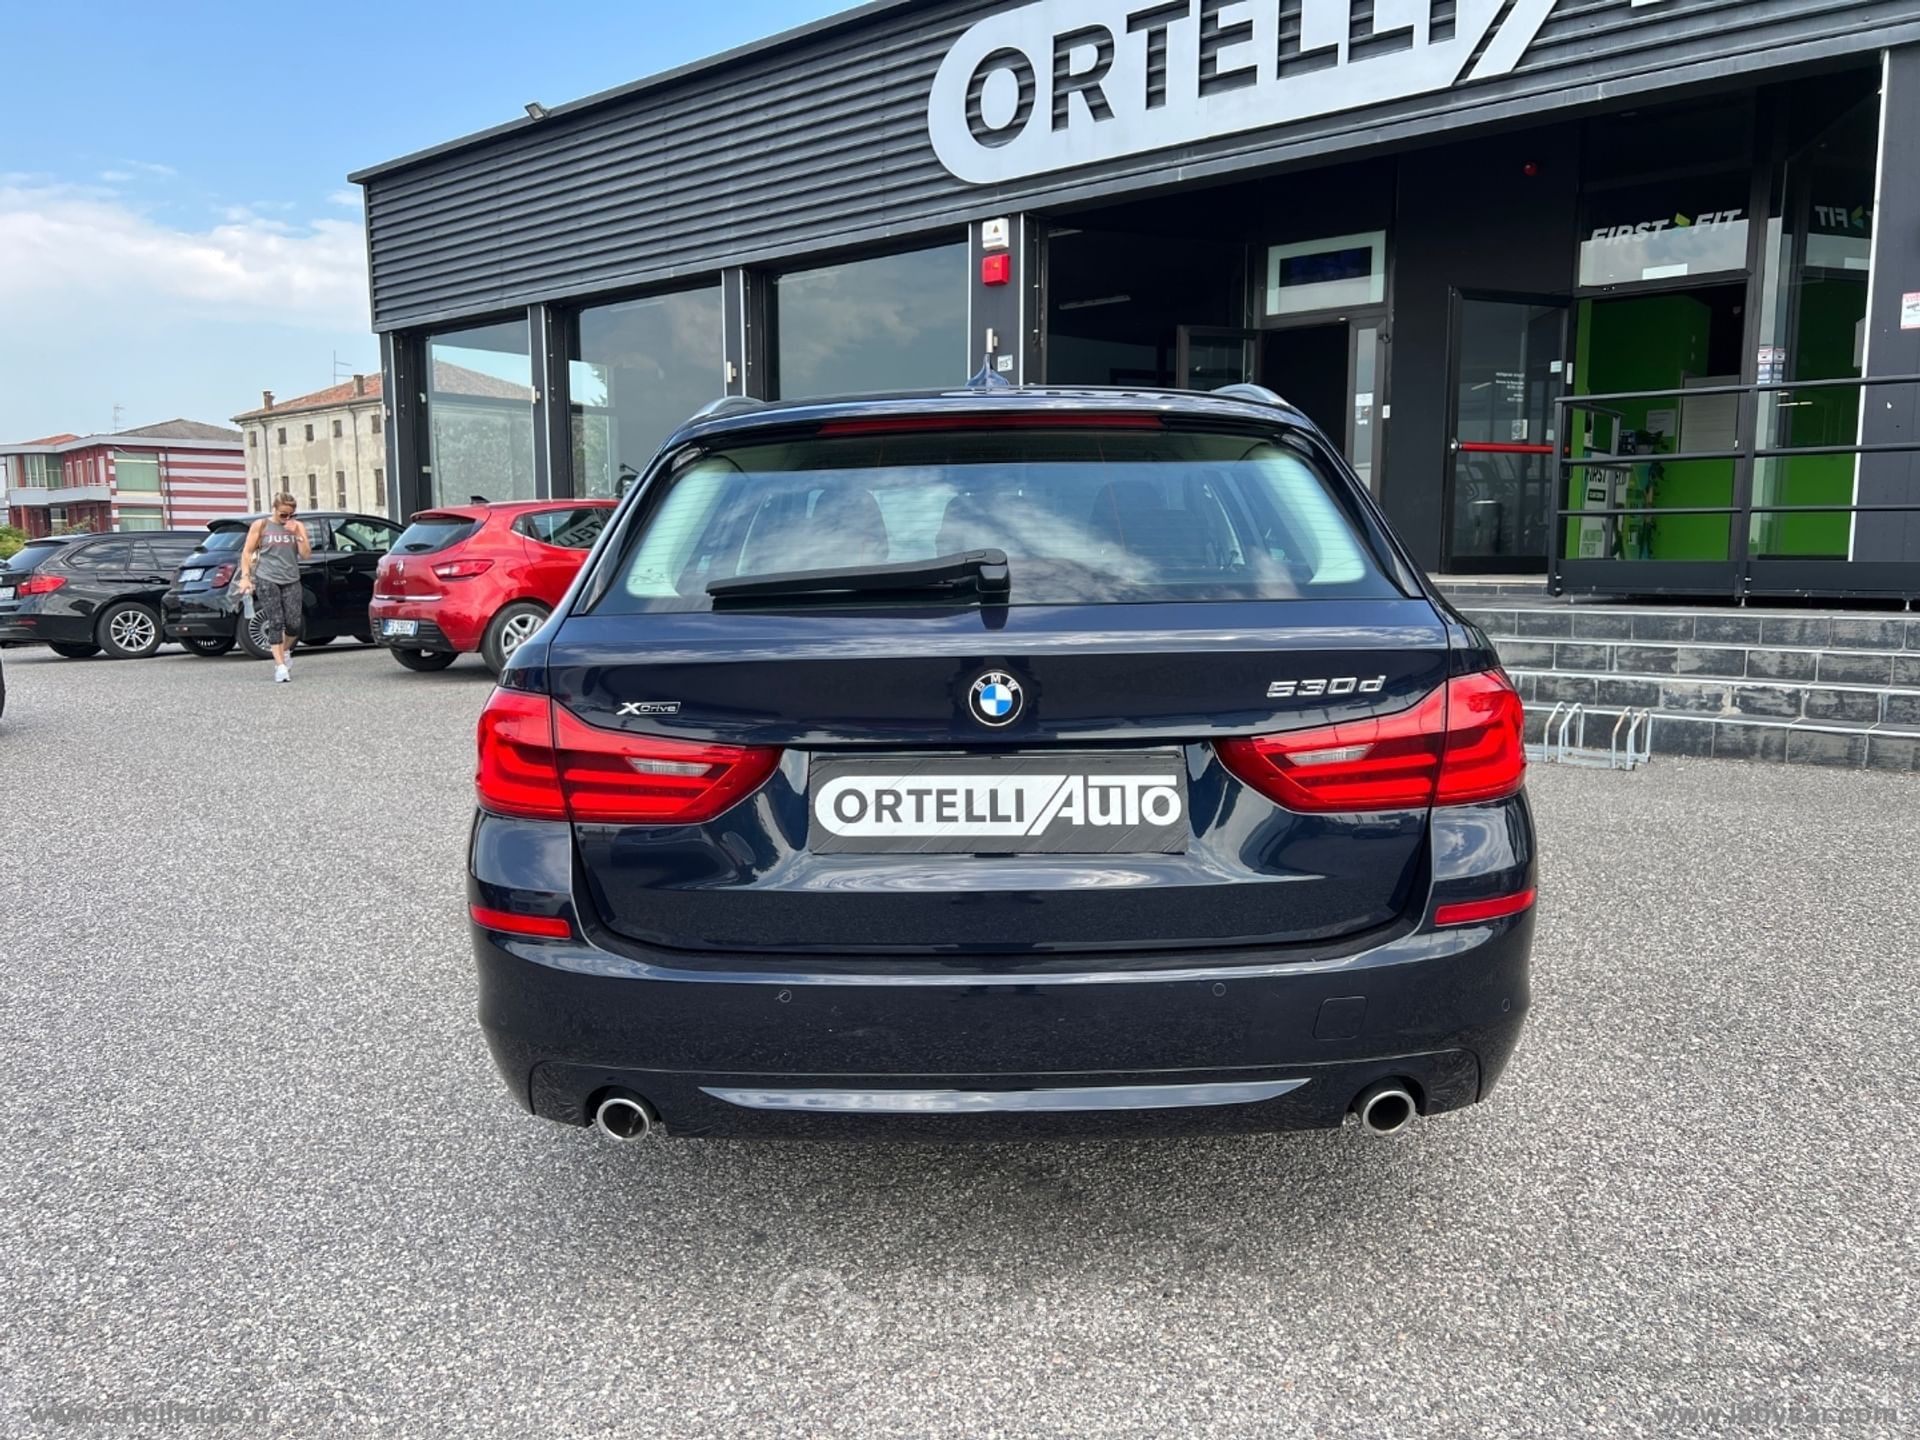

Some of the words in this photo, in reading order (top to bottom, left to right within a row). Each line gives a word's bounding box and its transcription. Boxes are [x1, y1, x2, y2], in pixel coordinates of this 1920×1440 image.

[1589, 218, 1669, 248] FIRST
[1691, 207, 1743, 234] FIT
[1266, 675, 1387, 698] 530d
[833, 788, 1025, 824] ORTELLI
